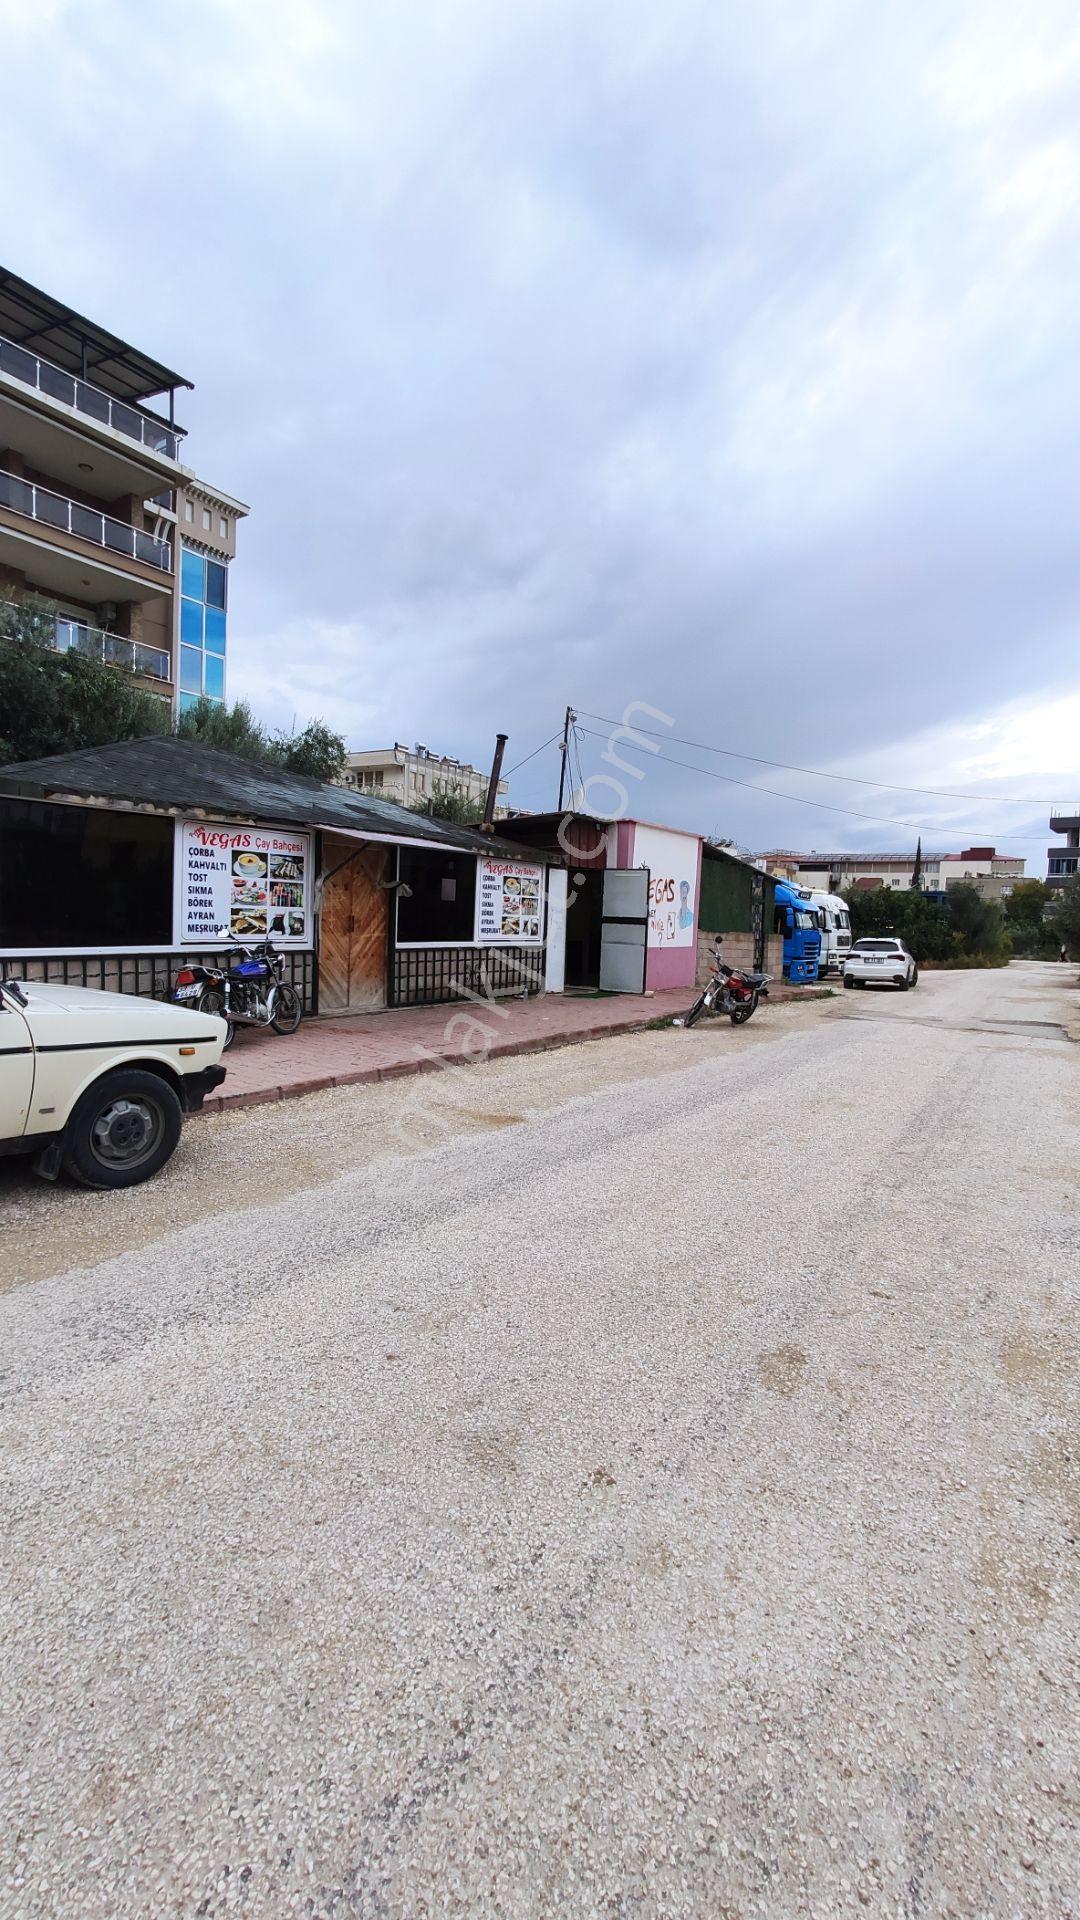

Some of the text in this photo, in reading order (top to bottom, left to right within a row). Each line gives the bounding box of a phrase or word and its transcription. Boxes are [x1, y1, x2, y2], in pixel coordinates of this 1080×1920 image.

[199, 832, 303, 852] VEGAS Çay Bahçesi
[188, 847, 215, 858] ÇORBA
[188, 860, 227, 871] KAHVALTI
[188, 873, 208, 882] TOST
[188, 886, 213, 895] SIKMA
[188, 897, 213, 907] BÖREK
[187, 911, 215, 920] AYRAN
